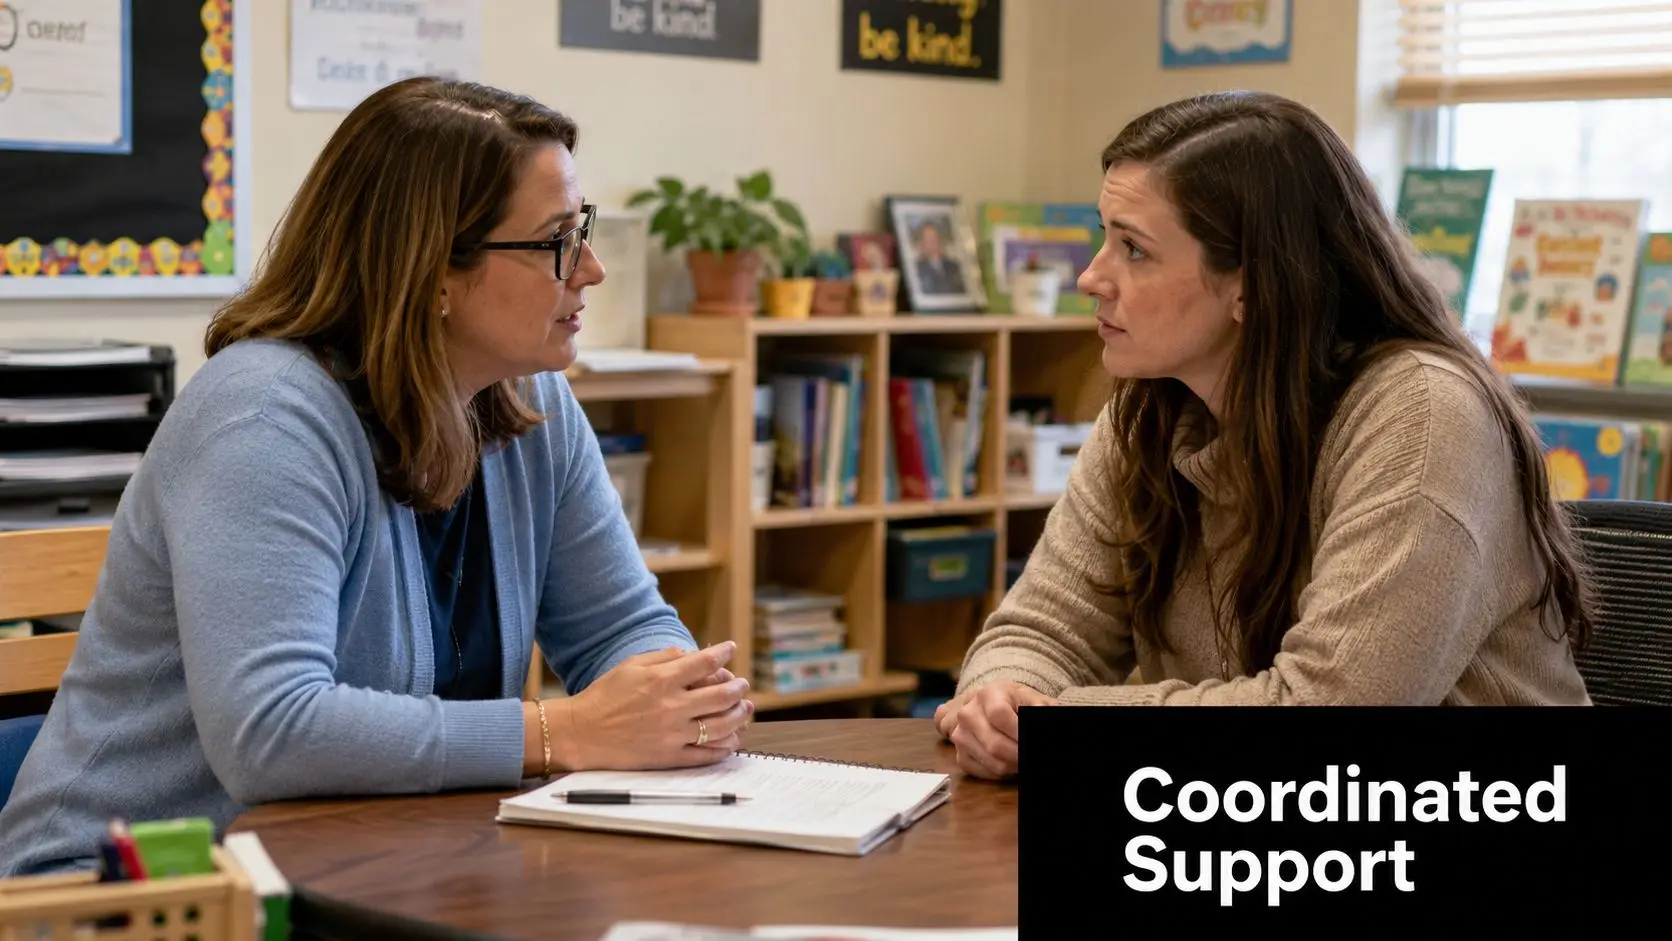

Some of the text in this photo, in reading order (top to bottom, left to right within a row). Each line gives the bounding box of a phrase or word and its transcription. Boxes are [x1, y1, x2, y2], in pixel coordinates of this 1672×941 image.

[611, 0, 645, 33] be
[859, 11, 981, 68] be kind.
